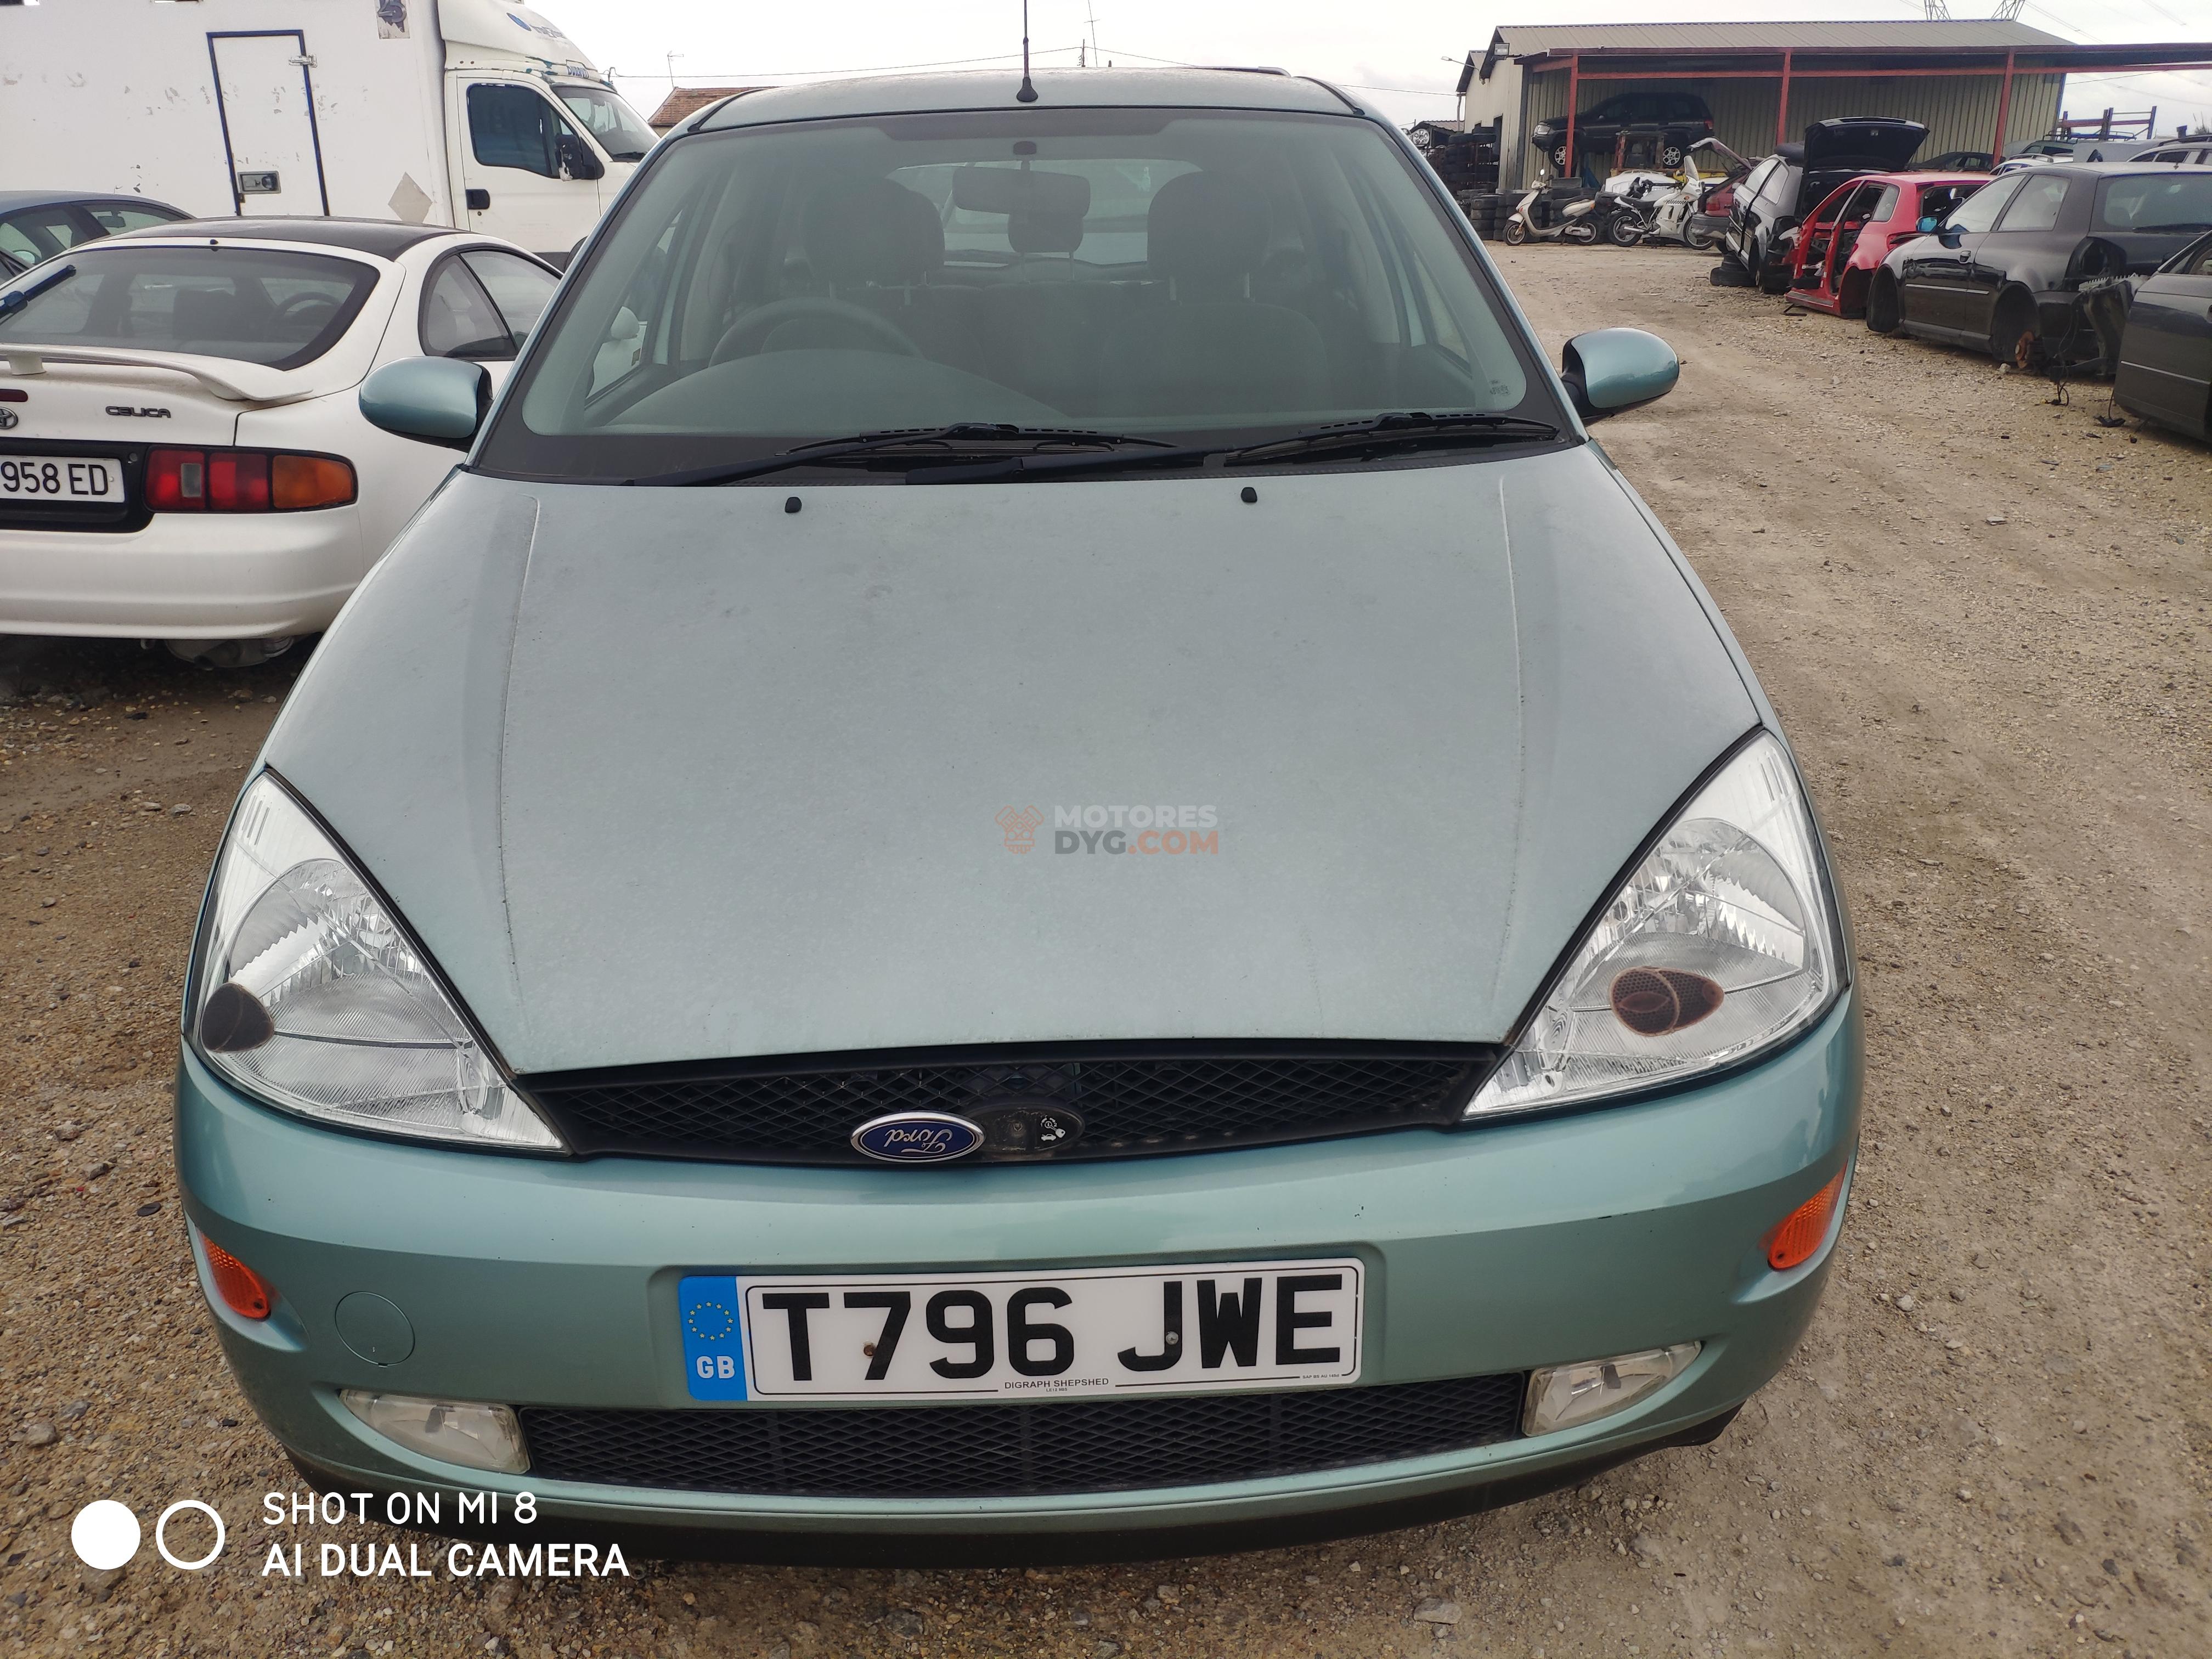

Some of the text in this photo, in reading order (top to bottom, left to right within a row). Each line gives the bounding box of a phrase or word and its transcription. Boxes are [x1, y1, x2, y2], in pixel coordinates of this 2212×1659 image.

[105, 406, 171, 419] CELICA
[1, 461, 109, 496] 958 ED
[883, 1128, 953, 1153] Ford
[762, 1273, 1342, 1381] T796 JWE
[696, 1356, 735, 1379] GB
[1005, 1378, 1109, 1389] DIGRAPH SHEPSHED
